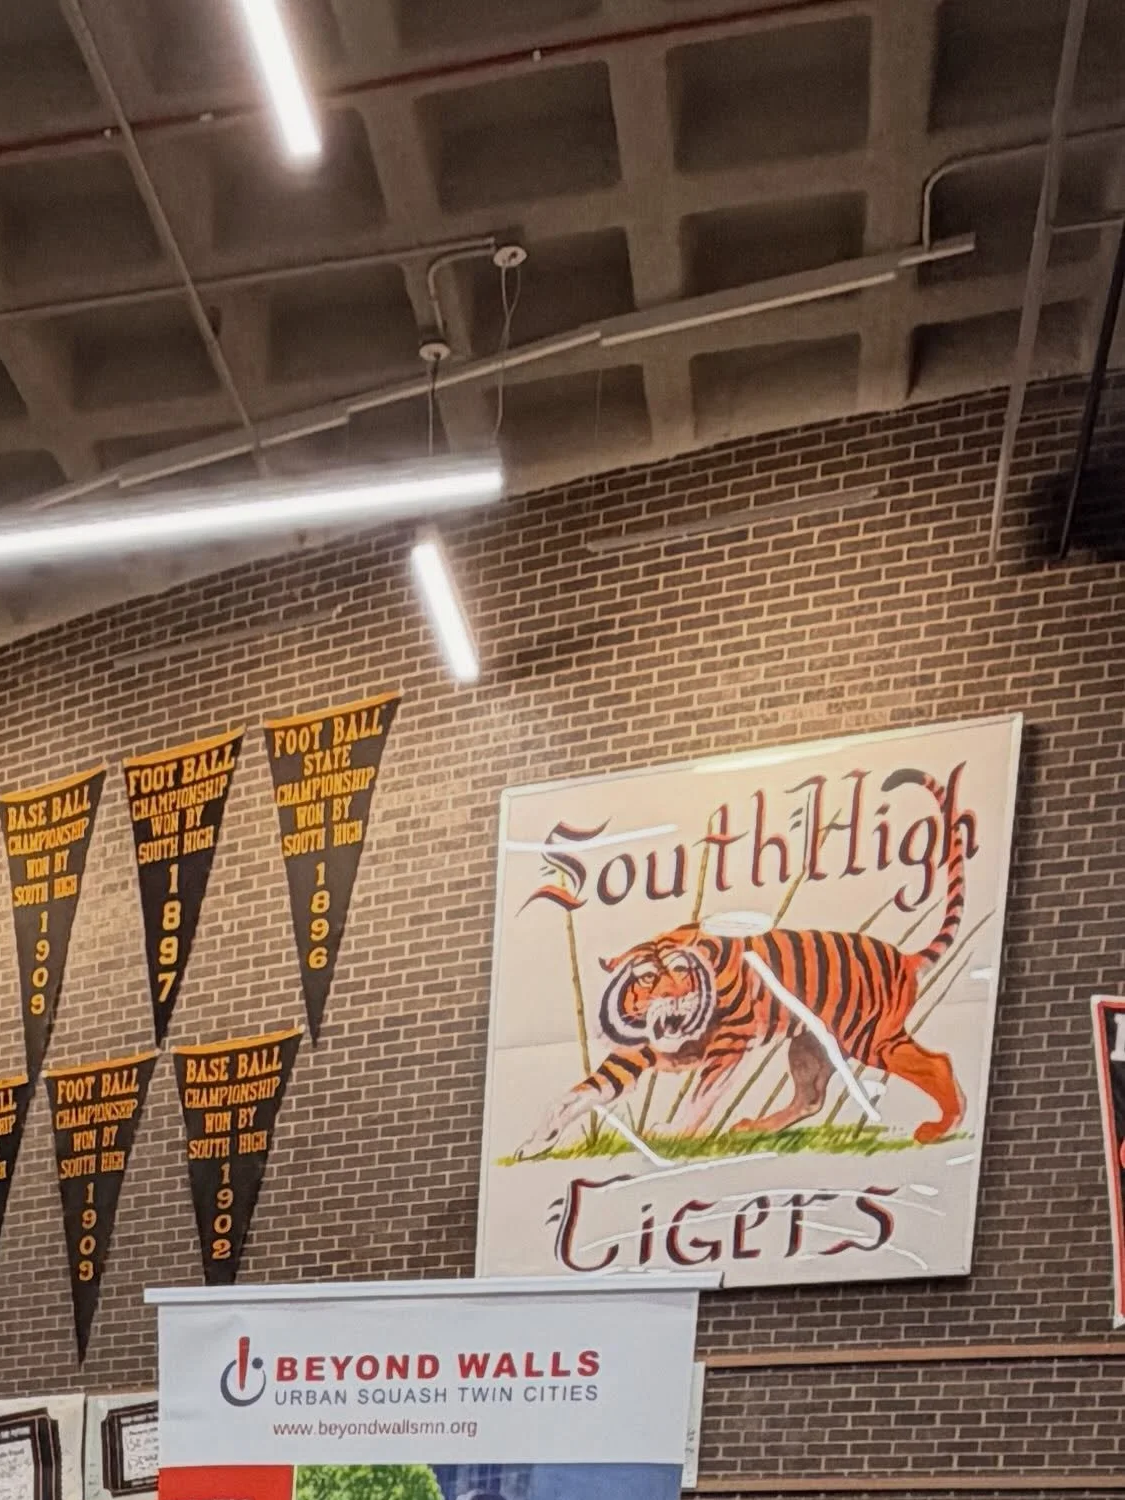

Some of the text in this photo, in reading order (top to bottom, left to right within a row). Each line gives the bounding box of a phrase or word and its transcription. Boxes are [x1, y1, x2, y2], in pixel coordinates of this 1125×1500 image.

[274, 708, 383, 758] FOOT BALL
[128, 744, 235, 797] FOOT BALL
[304, 745, 351, 776] STATE
[132, 774, 228, 821] CHAMPIONSHIP
[277, 766, 375, 807] CHAMPIONSHIP
[7, 785, 91, 832] BASE BALL
[151, 804, 204, 837] WON BY
[296, 796, 352, 829] WON BY
[8, 817, 90, 856] CHAMPIONSHIP
[138, 825, 214, 865] SOUTH HIGH
[284, 820, 363, 856] SOUTH HIGH
[515, 761, 979, 916] South High
[26, 849, 70, 880] WON BY
[14, 882, 48, 907] SOUTH
[309, 861, 330, 969] 1896
[158, 864, 181, 1003] 1897
[186, 1046, 282, 1084] BASE BALL
[57, 1067, 139, 1106] FOOT BALL
[185, 1076, 281, 1109] CHAMPIONSHIP
[56, 1099, 138, 1130] CHAMPIONSHIP
[205, 1106, 257, 1133] WON BY
[73, 1125, 119, 1152] WON BY
[189, 1131, 267, 1160] SOUTH HIGH
[60, 1154, 96, 1180] SOUTH
[212, 1163, 234, 1260] 1902
[275, 1349, 601, 1382] BEYOND WALLS
[275, 1384, 599, 1406] URBAN SQUASH TWIN CITIES
[273, 1419, 478, 1439] www.beyondwallsmn.org
